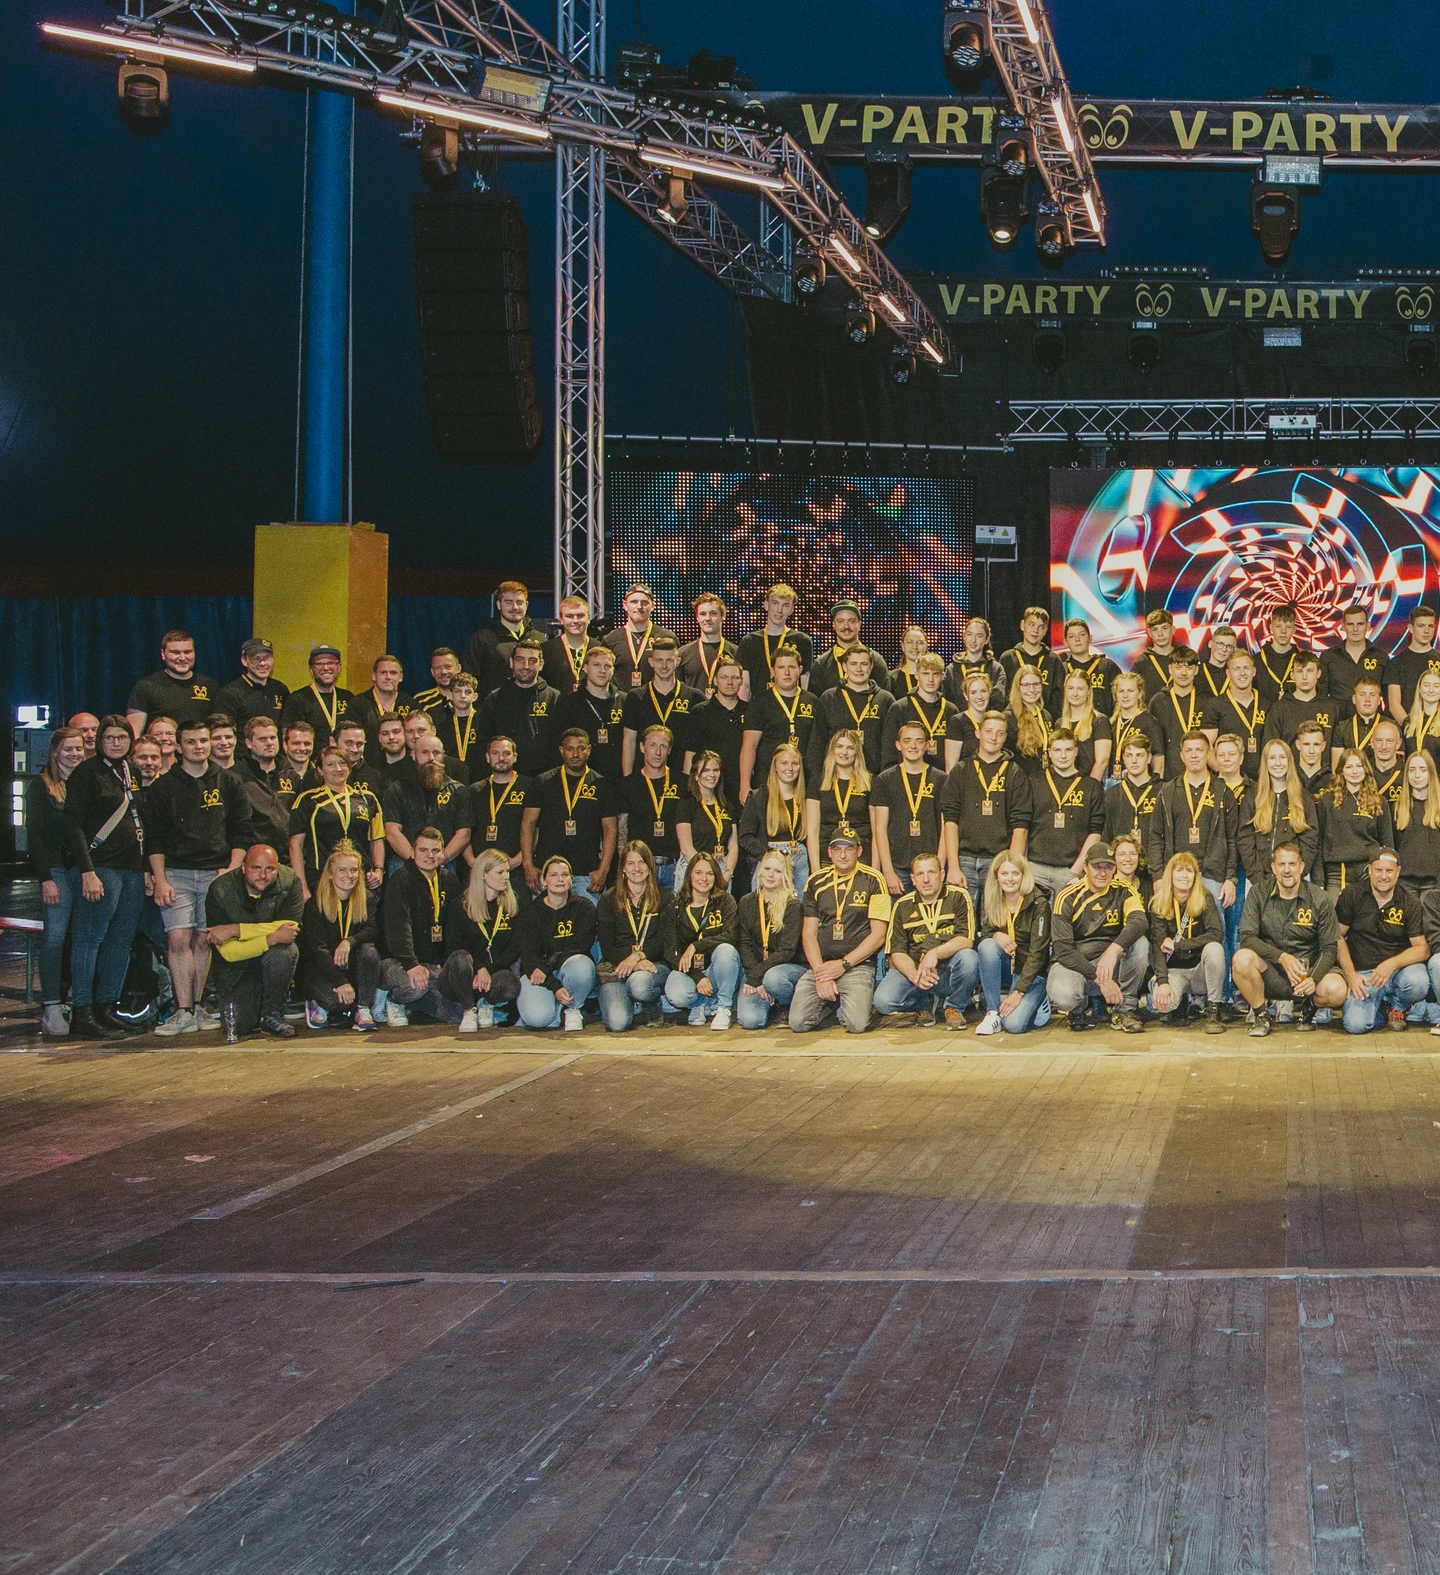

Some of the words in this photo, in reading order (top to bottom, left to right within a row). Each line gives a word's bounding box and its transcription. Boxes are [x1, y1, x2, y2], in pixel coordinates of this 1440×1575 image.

[801, 103, 1000, 145] V-PART
[1169, 110, 1410, 152] V-PARTY
[938, 283, 1111, 315] V-PARTY
[1201, 287, 1371, 319] V-PARTY
